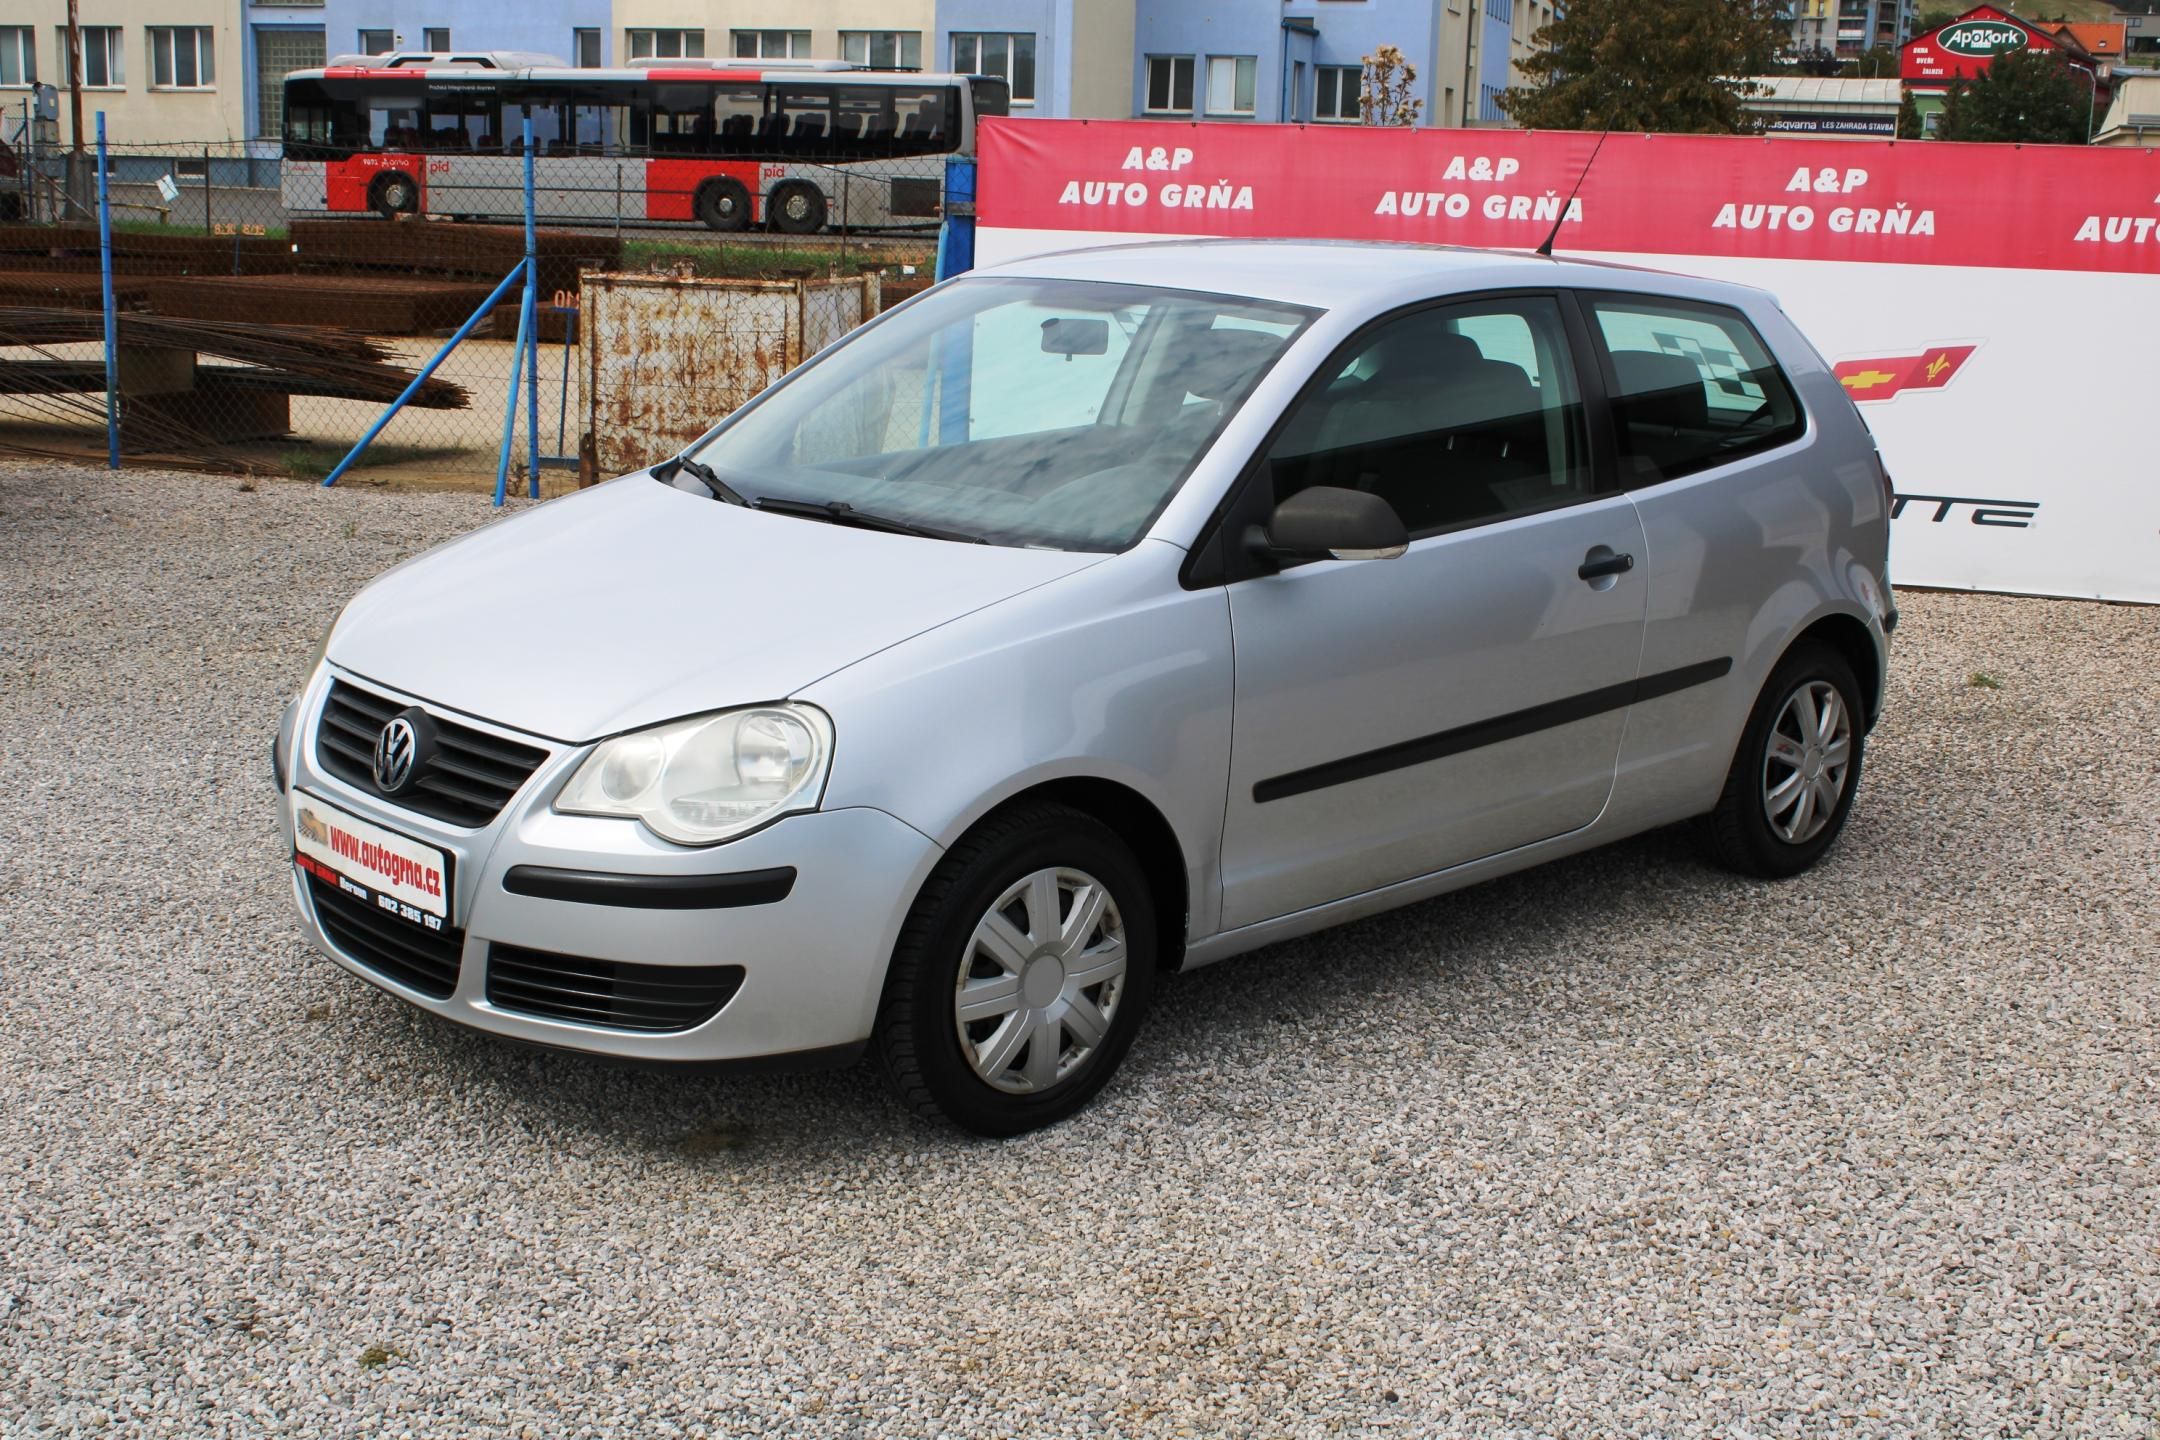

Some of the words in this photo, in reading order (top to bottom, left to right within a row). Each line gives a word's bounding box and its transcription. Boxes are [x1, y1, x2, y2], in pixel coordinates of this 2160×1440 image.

[1868, 122, 1894, 131] STAVBA
[430, 160, 449, 174] pid
[1121, 146, 1194, 171] A&P
[1443, 156, 1520, 181] A&P
[763, 165, 785, 180] pid
[1785, 167, 1869, 193] A&P
[1058, 181, 1149, 207] AUTO
[1160, 179, 1254, 210] GRŇA
[1374, 191, 1470, 218] AUTO
[1482, 190, 1583, 222] GRŇA
[1712, 203, 1814, 231] AUTO
[1828, 202, 1935, 236] GRŇA
[2073, 216, 2160, 243] AUT
[330, 825, 441, 898] www.autogrna.cz
[377, 894, 399, 914] 602
[423, 913, 442, 931] 197
